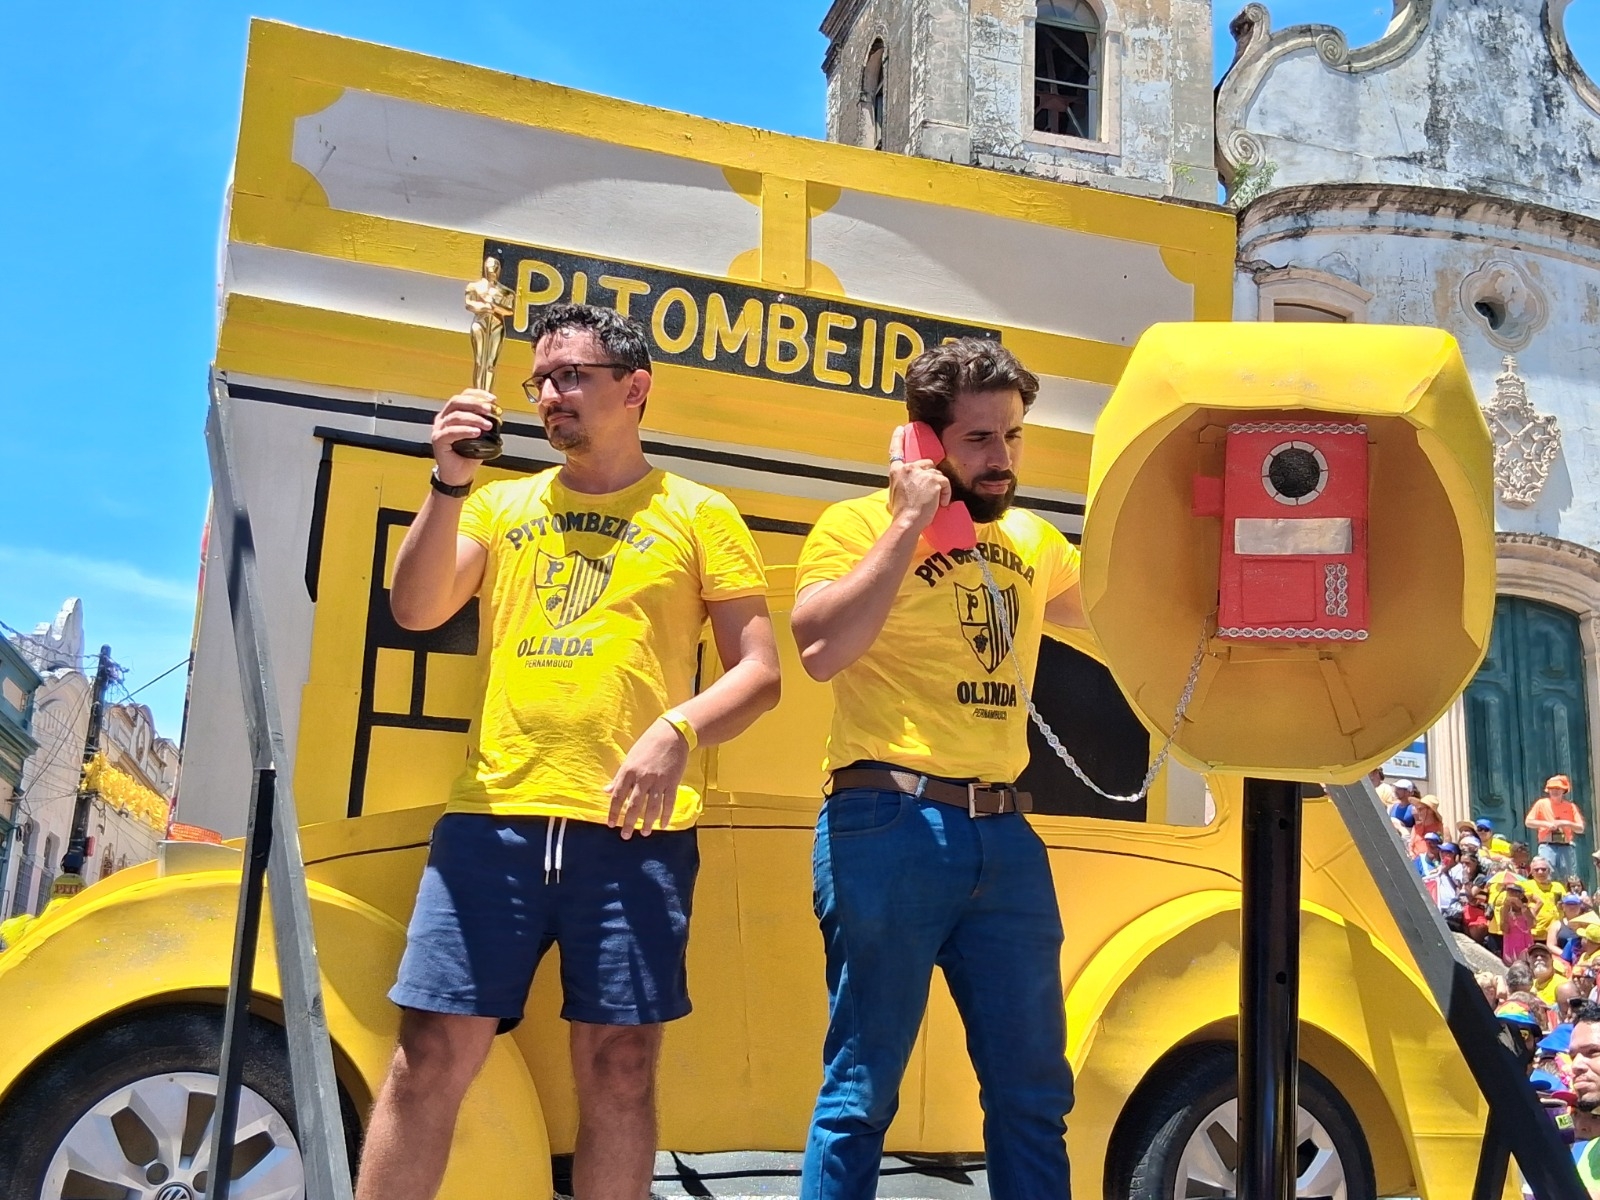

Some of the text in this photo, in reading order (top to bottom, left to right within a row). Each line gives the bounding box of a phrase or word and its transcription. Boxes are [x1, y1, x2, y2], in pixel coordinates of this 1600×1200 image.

[513, 258, 960, 395] PTOMBEIR
[505, 511, 657, 554] PITOMBEIRA
[517, 636, 594, 658] OLINDA
[524, 659, 573, 668] PERNAMBUCO
[957, 681, 1017, 708] OLINDA
